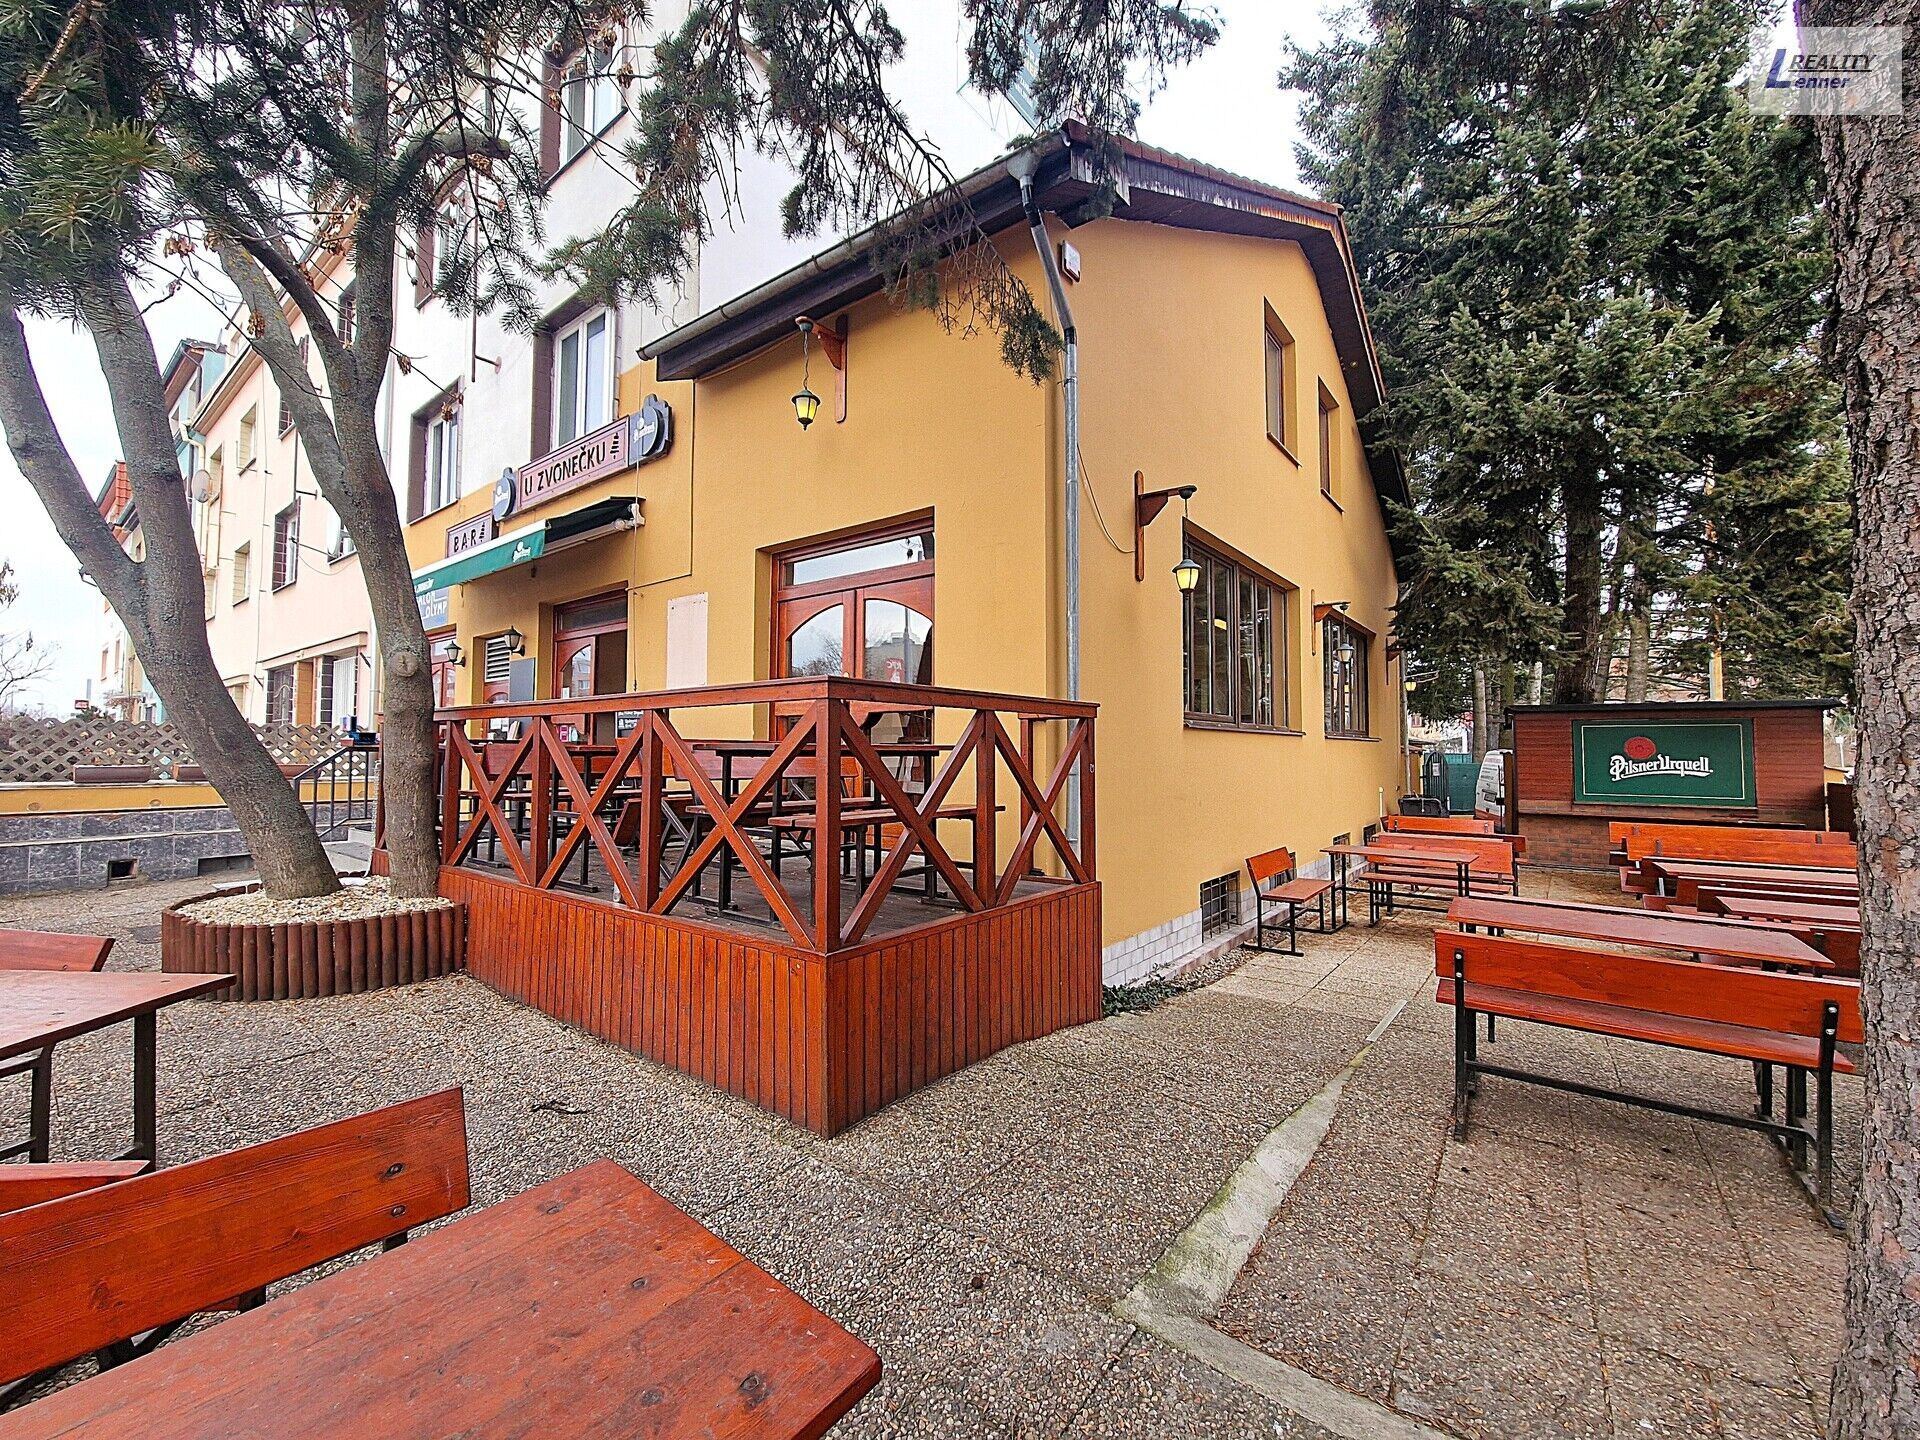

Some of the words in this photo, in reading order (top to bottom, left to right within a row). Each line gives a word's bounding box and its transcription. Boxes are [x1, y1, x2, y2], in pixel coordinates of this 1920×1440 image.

[524, 477, 533, 496] U
[537, 441, 606, 491] ZVONEČKU
[453, 529, 477, 553] BAR
[425, 600, 448, 618] OLYMP
[1610, 755, 1661, 781] Pilsner
[1658, 754, 1713, 777] Urquell
